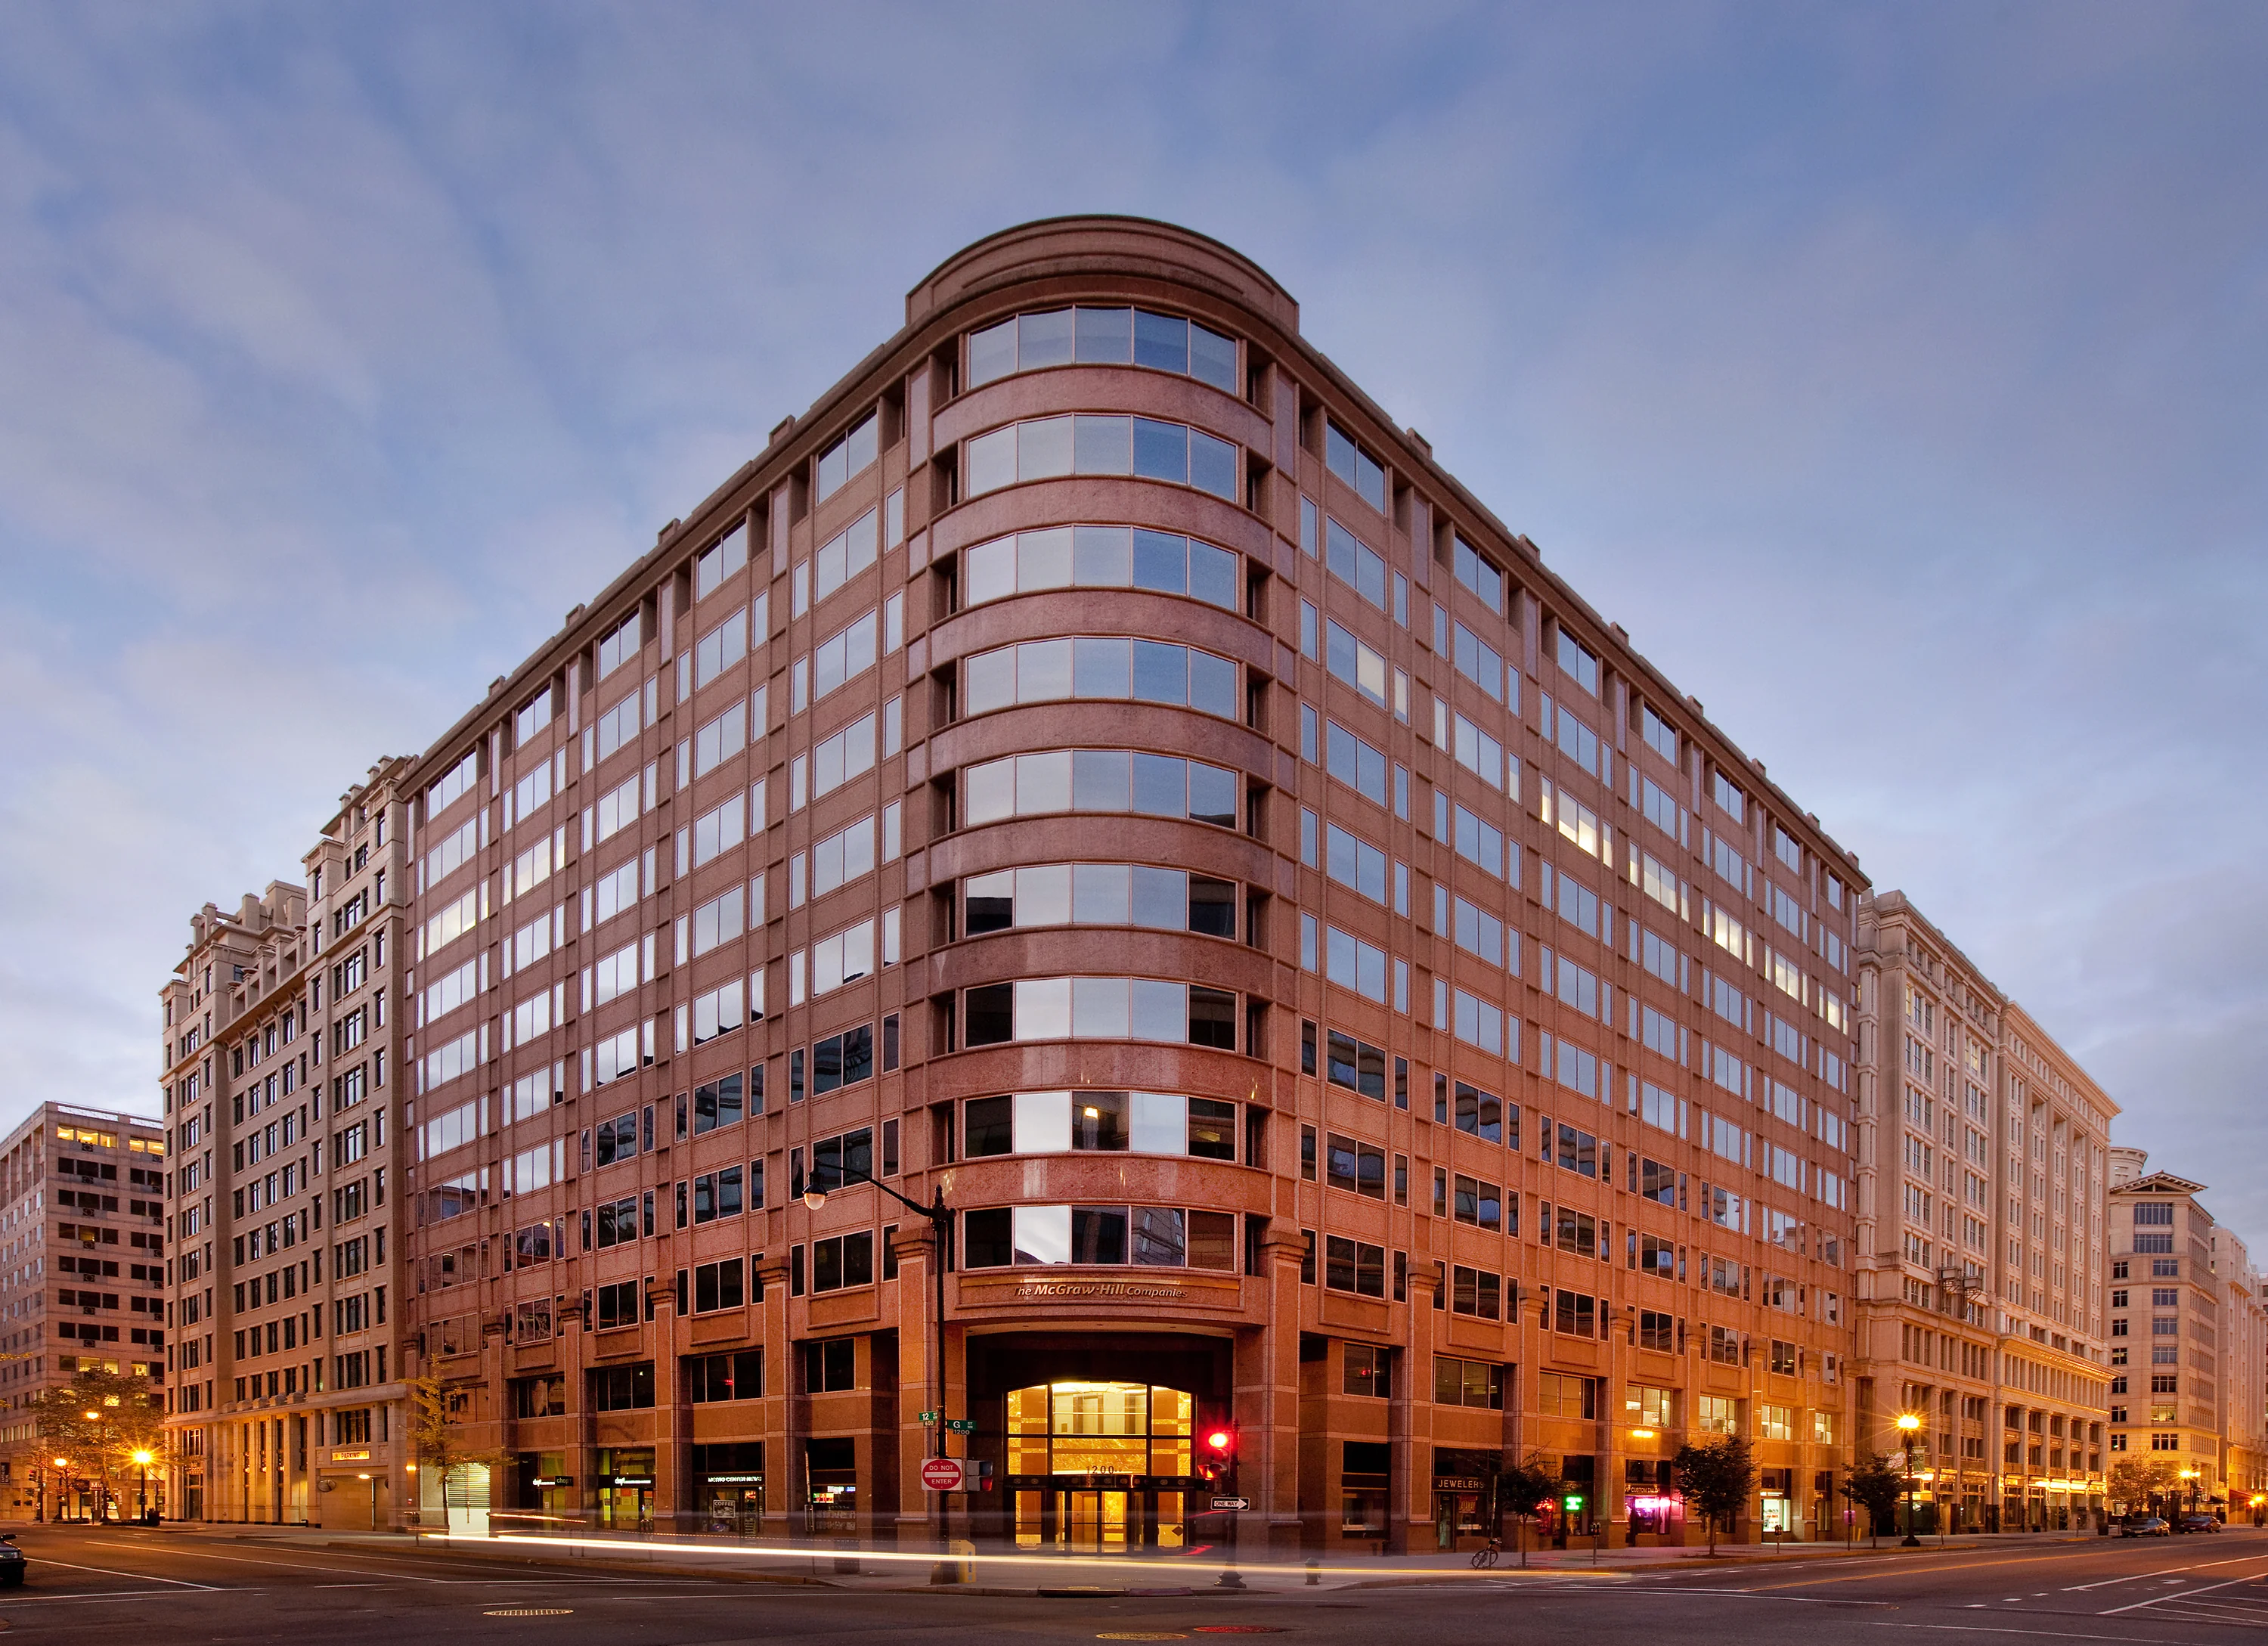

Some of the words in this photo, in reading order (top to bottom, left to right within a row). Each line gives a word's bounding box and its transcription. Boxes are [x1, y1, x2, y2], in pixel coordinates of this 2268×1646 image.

[1015, 1286, 1031, 1295] The
[1126, 1286, 1188, 1297] Companies
[1086, 1465, 1114, 1474] 1200
[1438, 1480, 1485, 1488] JEWELERS
